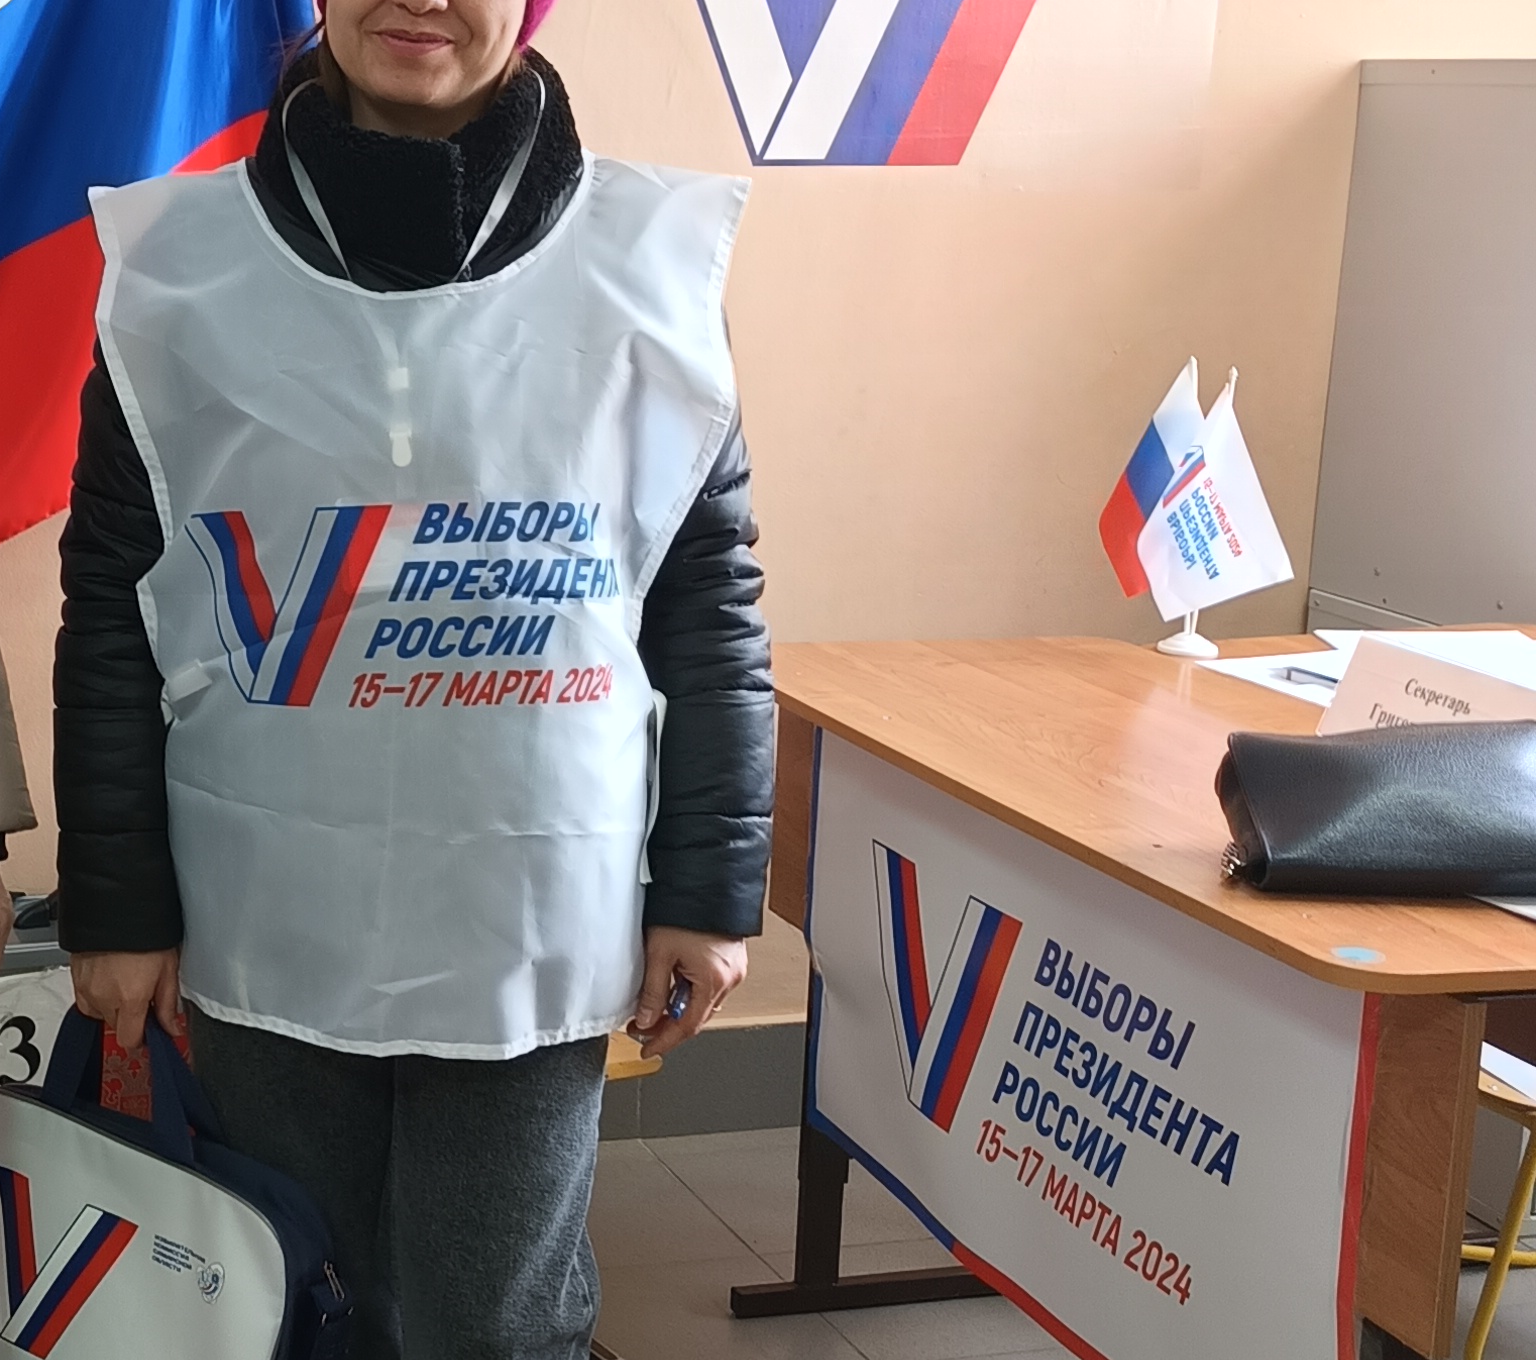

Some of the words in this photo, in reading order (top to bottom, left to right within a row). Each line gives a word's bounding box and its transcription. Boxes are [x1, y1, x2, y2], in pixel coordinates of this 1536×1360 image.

[412, 501, 601, 545] ВЫБОРЫ
[364, 614, 556, 660] РОССИИ
[442, 669, 555, 707] МАРТА
[555, 662, 614, 704] 2024
[1404, 677, 1471, 717] Секретарь
[1368, 702, 1418, 730] Григо
[1033, 937, 1197, 1071] ВЫБОРЫ
[1012, 1000, 1241, 1188] ПРЕЗИДЕНТА
[991, 1060, 1128, 1189] РОССИИ
[1040, 1163, 1124, 1258] МАРТА
[1122, 1228, 1194, 1307] 2024
